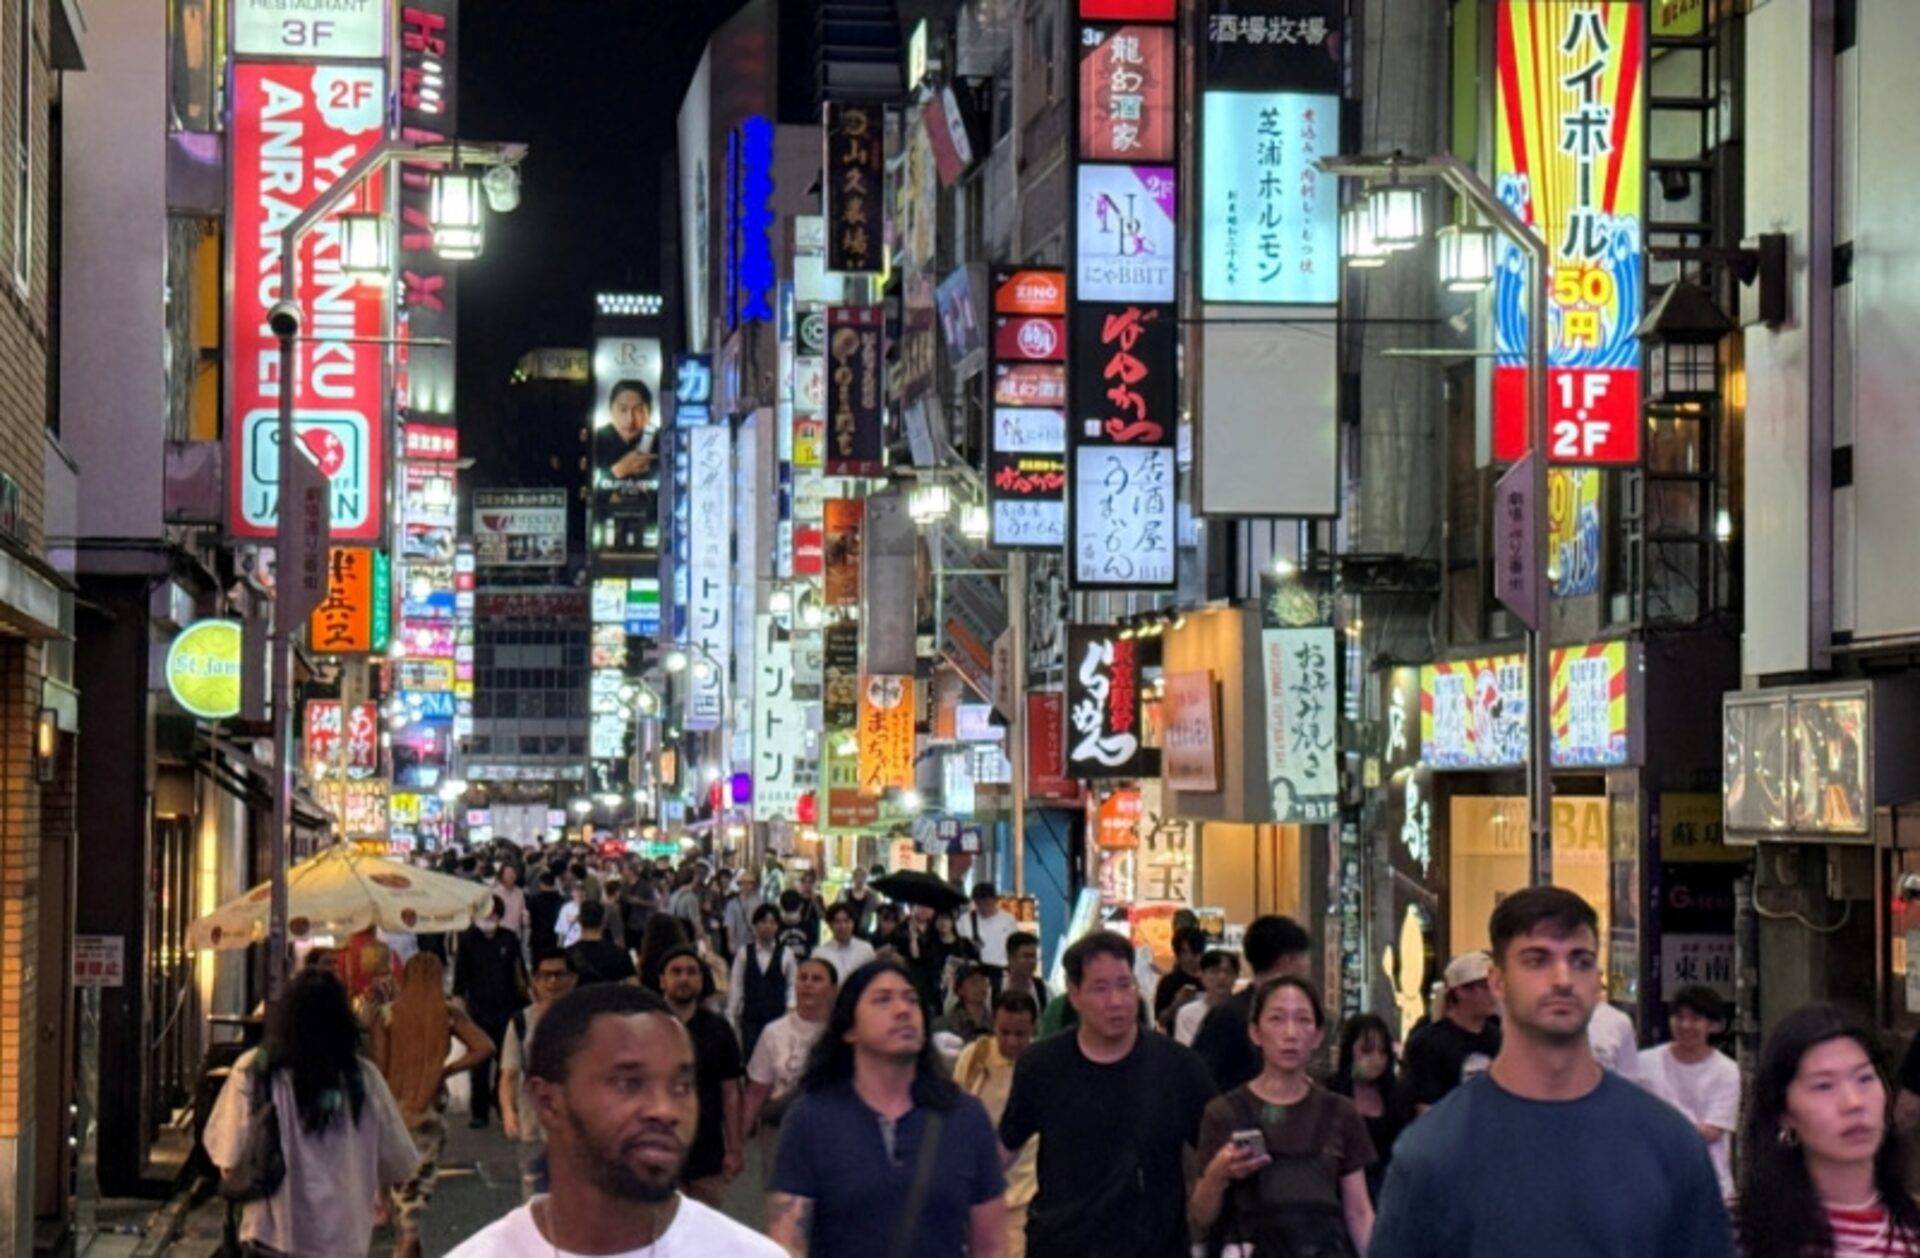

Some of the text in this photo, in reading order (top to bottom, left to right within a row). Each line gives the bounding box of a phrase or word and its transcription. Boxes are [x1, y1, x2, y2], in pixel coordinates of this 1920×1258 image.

[282, 19, 335, 46] 3F
[330, 80, 374, 108] 2F
[1563, 12, 1610, 257] ハイボール
[1257, 107, 1283, 283] 芝浦ホルモン
[1557, 373, 1611, 410] 1F
[1553, 420, 1611, 458] 2F
[1290, 642, 1333, 779] お好み焼き
